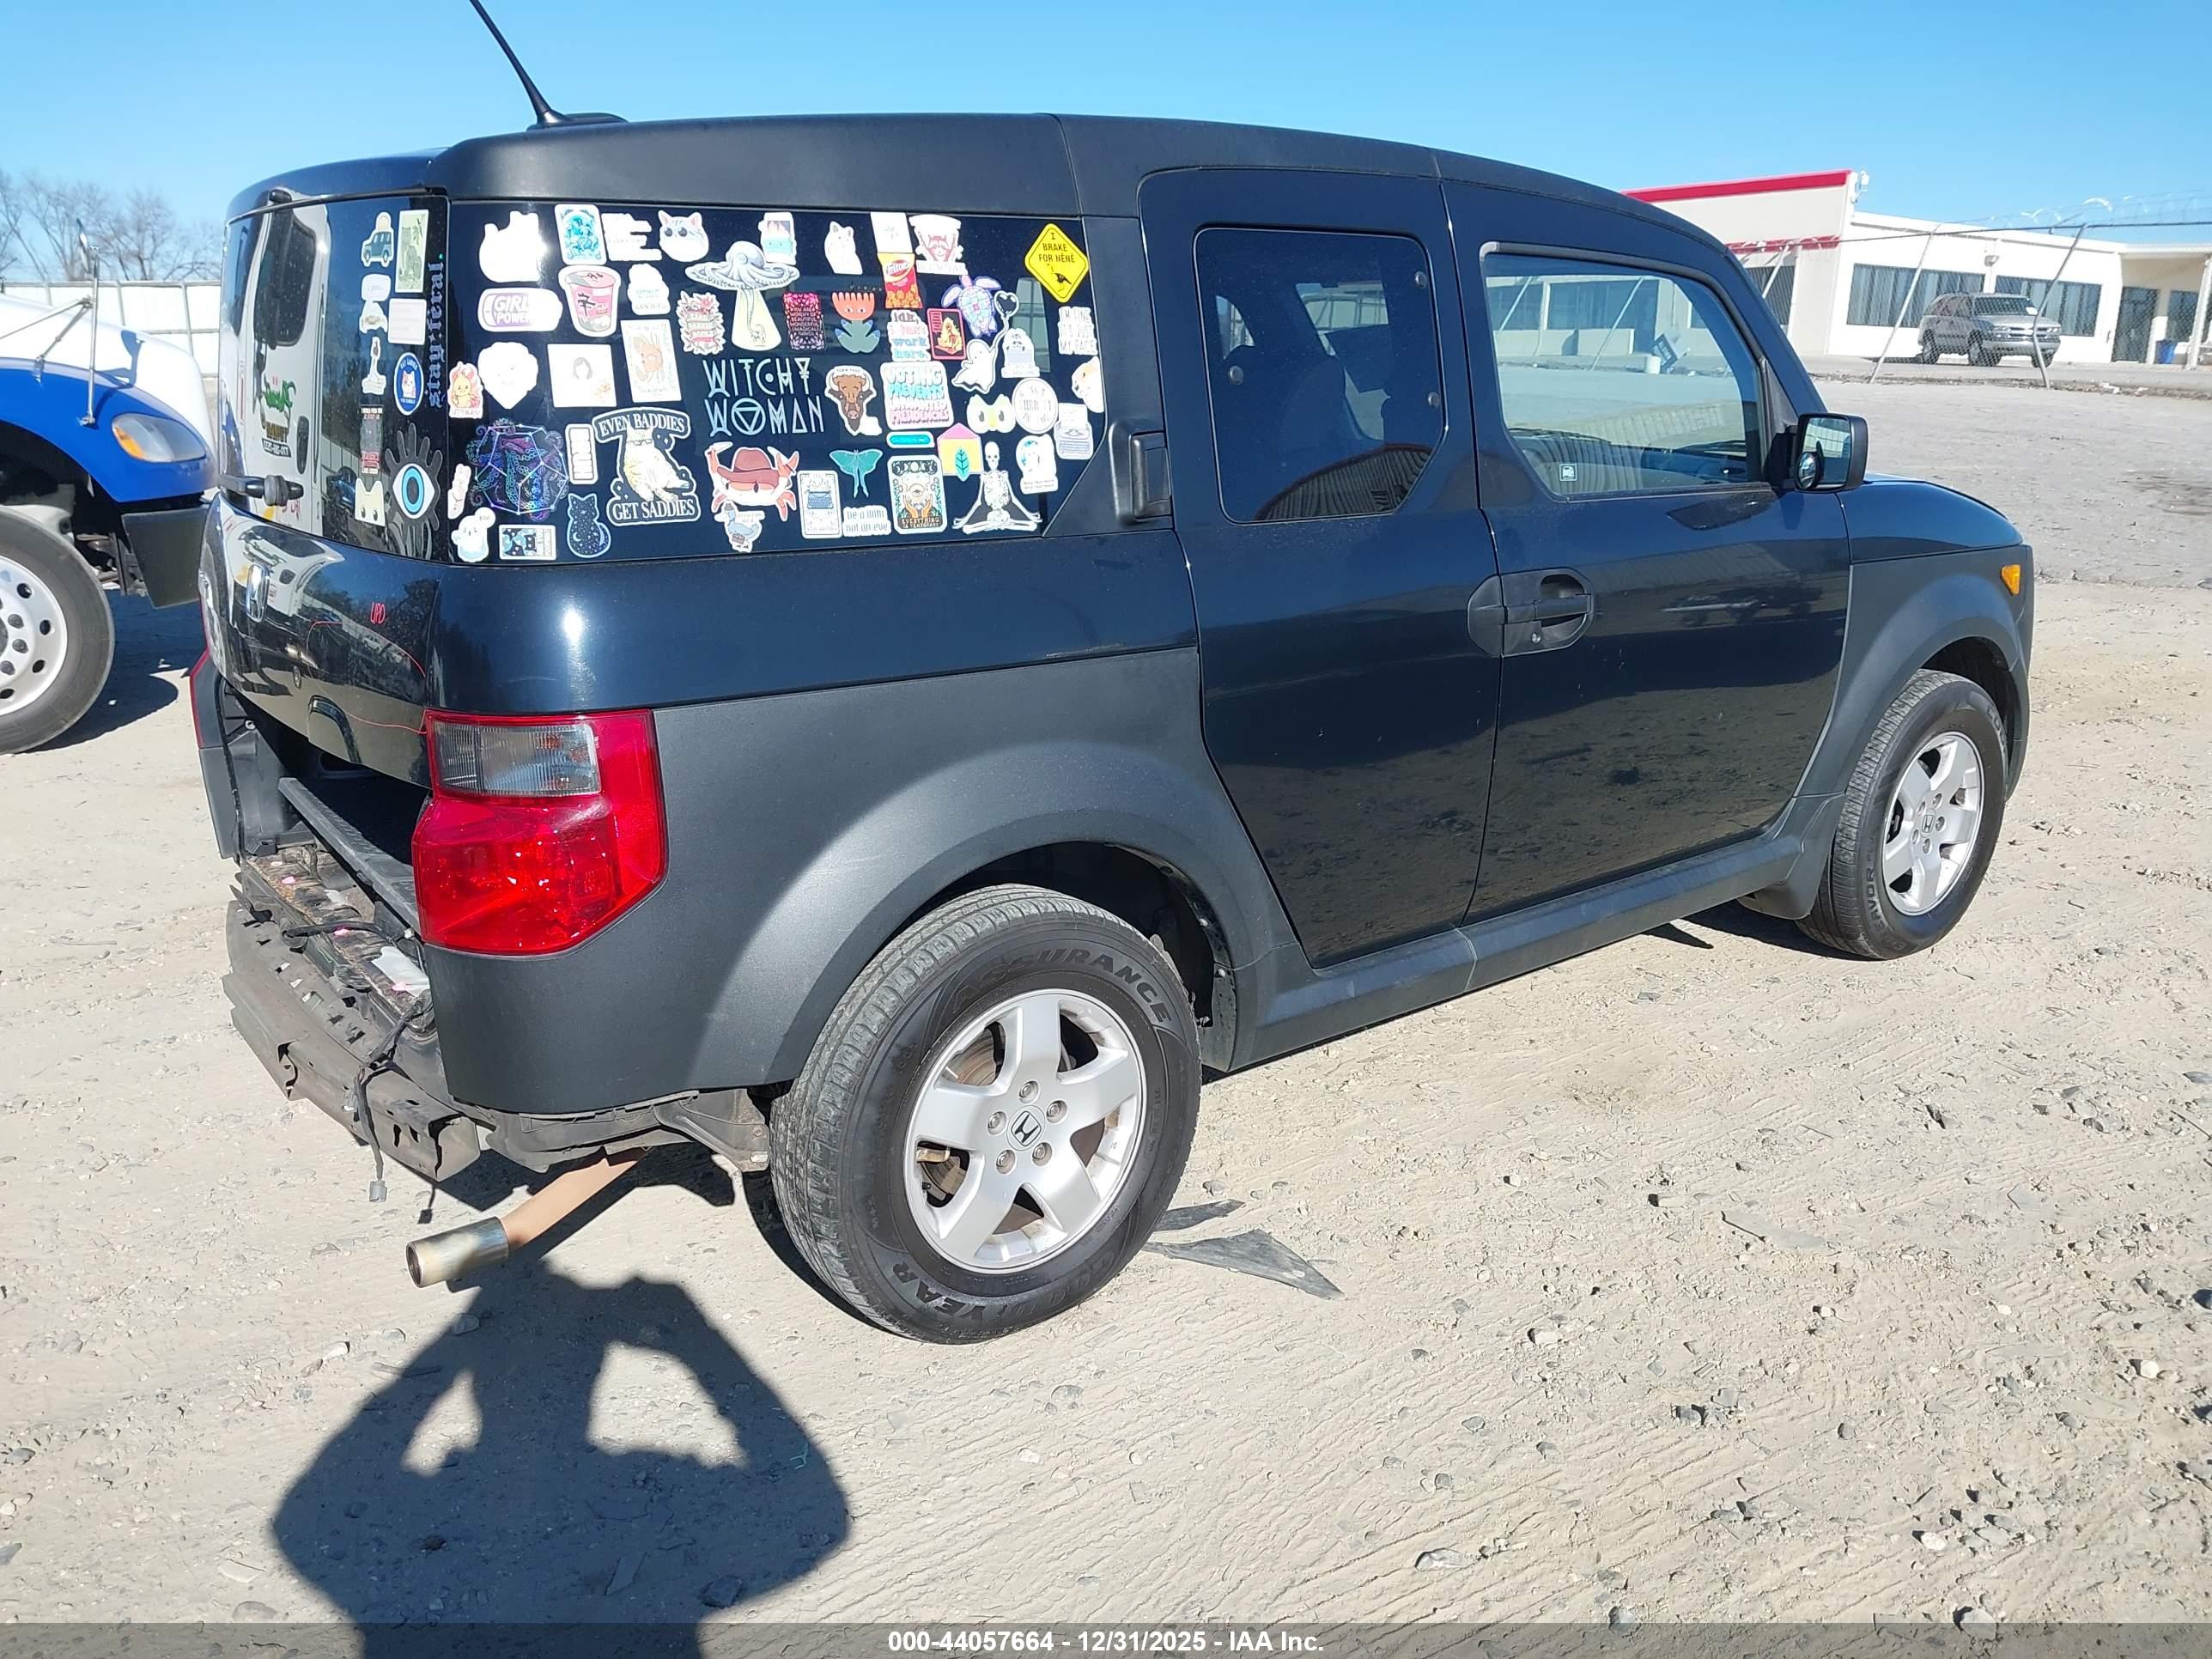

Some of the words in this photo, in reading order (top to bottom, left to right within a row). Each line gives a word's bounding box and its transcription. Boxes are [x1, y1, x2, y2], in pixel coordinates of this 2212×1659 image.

[1050, 232, 1056, 240] I
[1042, 243, 1067, 252] BRAKE
[426, 261, 444, 331] feral
[494, 295, 530, 313] GIRL
[892, 336, 927, 346] work
[702, 357, 811, 398] WITCHY
[599, 416, 629, 436] EVEN
[633, 413, 685, 433] BADDIES
[704, 395, 824, 437] WOMAN
[612, 502, 639, 520] GET
[641, 499, 695, 519] SADDIES
[952, 948, 1173, 1023] ASSURANCE
